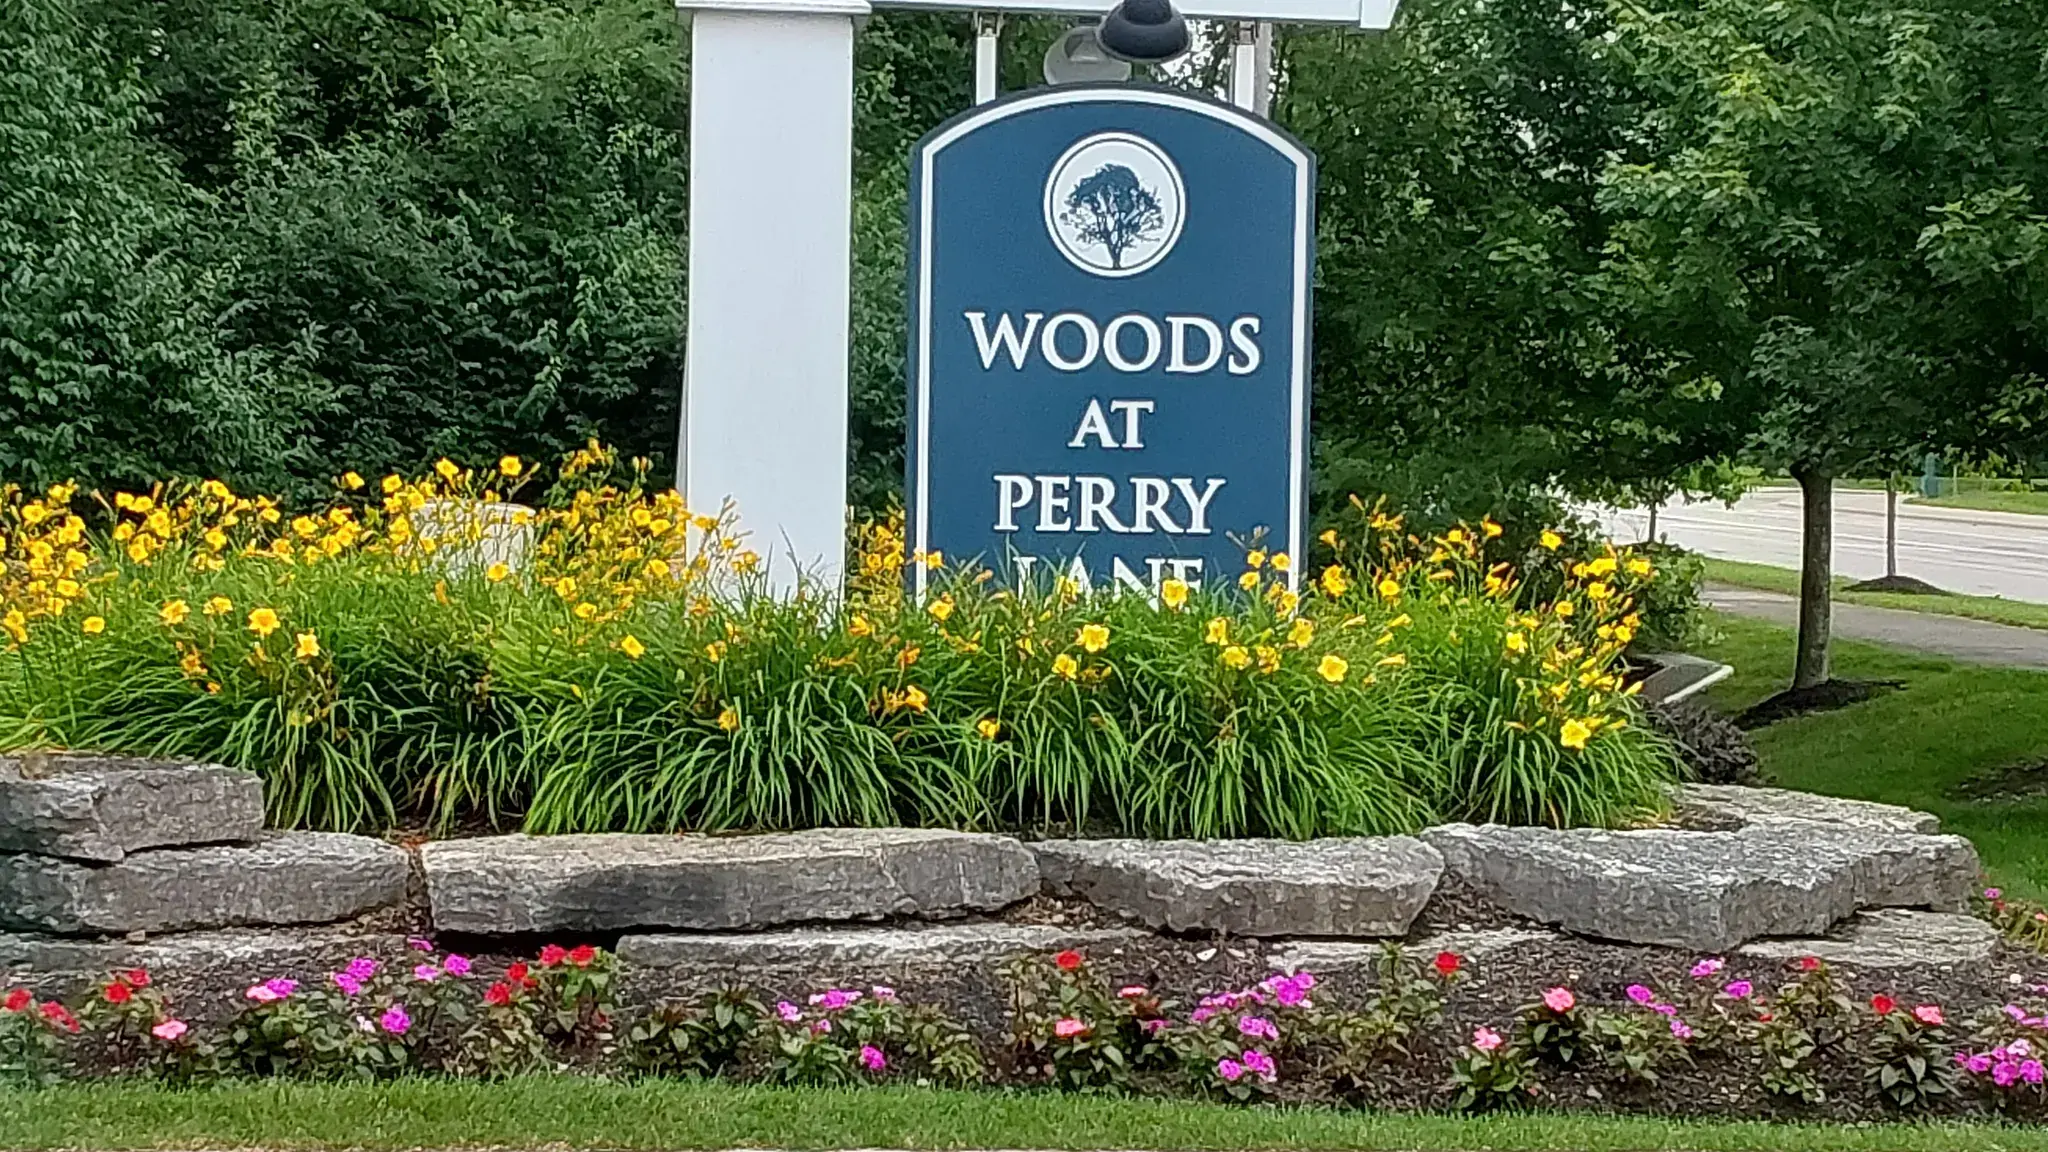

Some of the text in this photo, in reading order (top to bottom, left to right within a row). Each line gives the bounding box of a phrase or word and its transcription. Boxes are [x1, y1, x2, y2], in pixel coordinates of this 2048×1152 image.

[964, 312, 1261, 374] WOODS
[1068, 397, 1154, 448] AT
[993, 475, 1227, 535] PERRY
